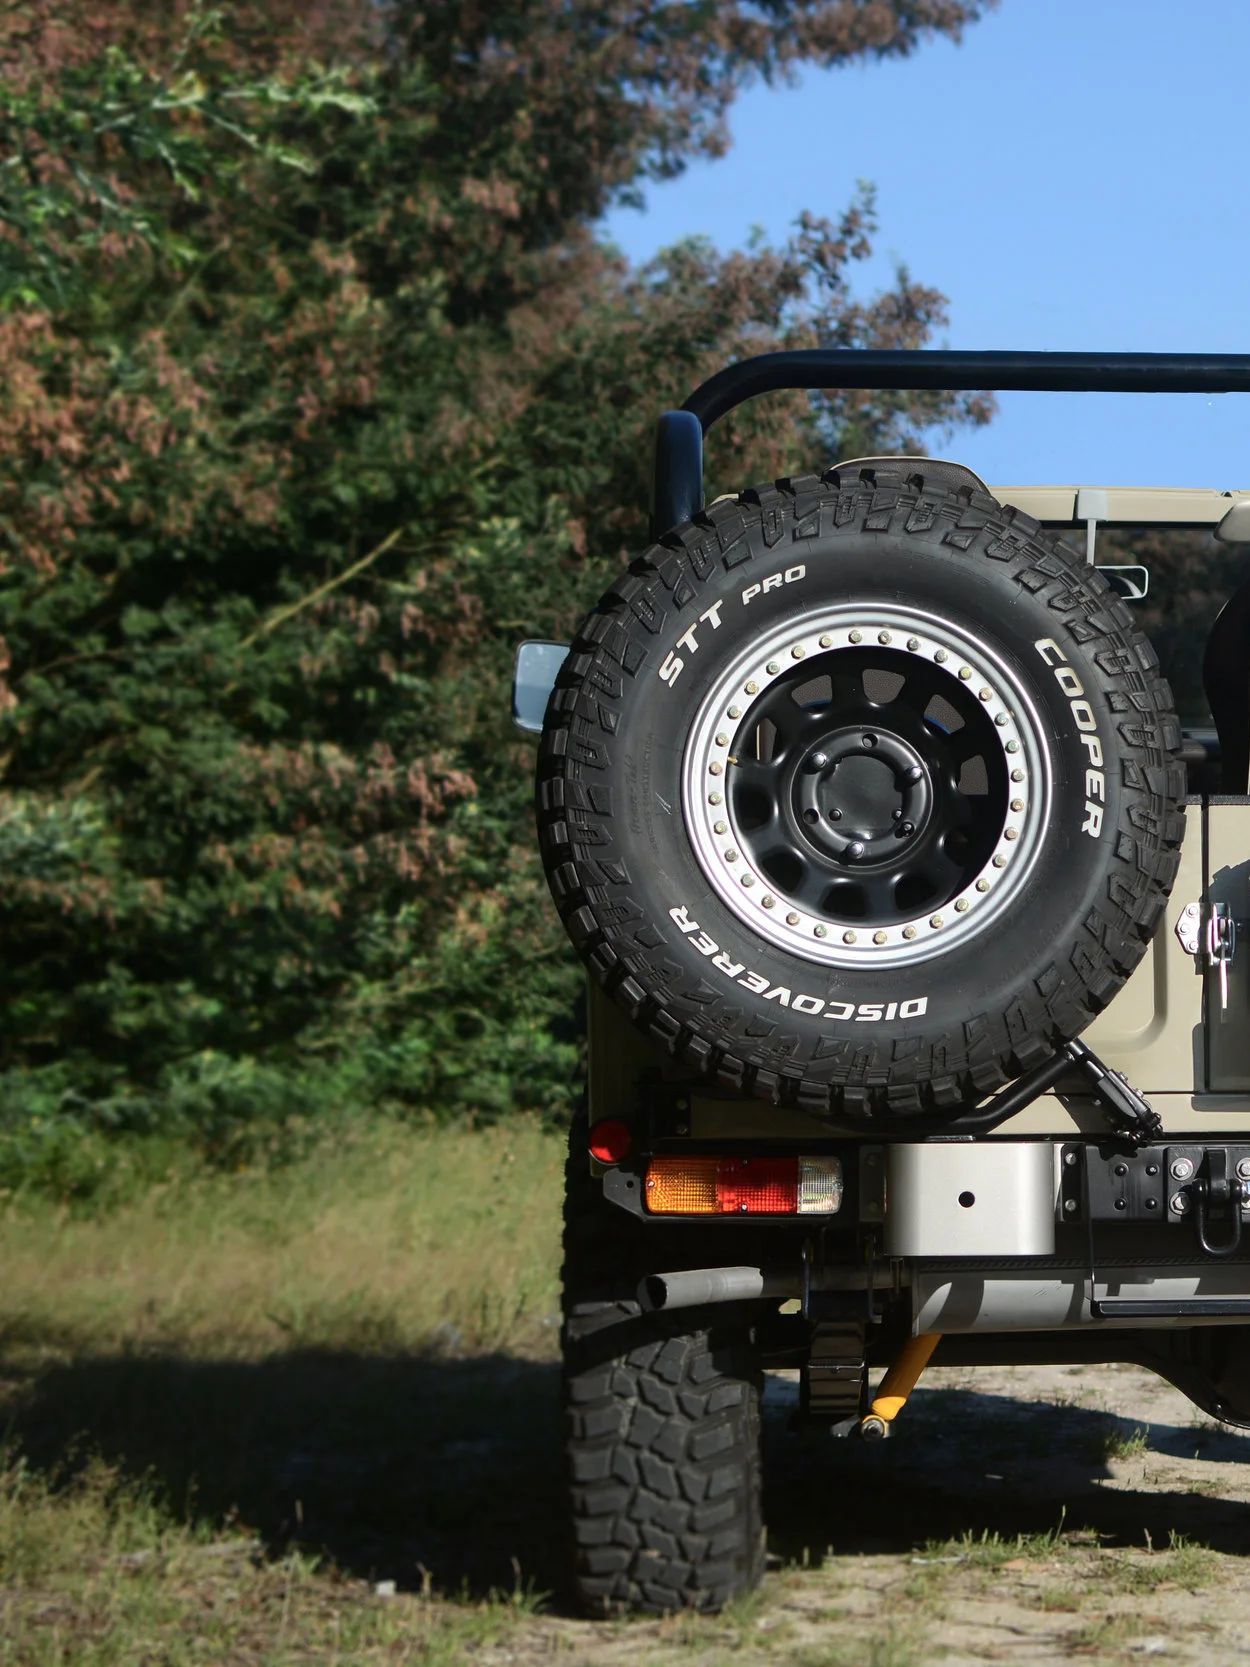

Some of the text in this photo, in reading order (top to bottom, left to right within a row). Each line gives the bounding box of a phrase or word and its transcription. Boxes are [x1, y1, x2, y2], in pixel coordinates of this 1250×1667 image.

[659, 598, 723, 689] STT
[741, 564, 806, 605] PRO
[1034, 637, 1105, 839] COOPER
[668, 904, 929, 1022] DISCOVERER
